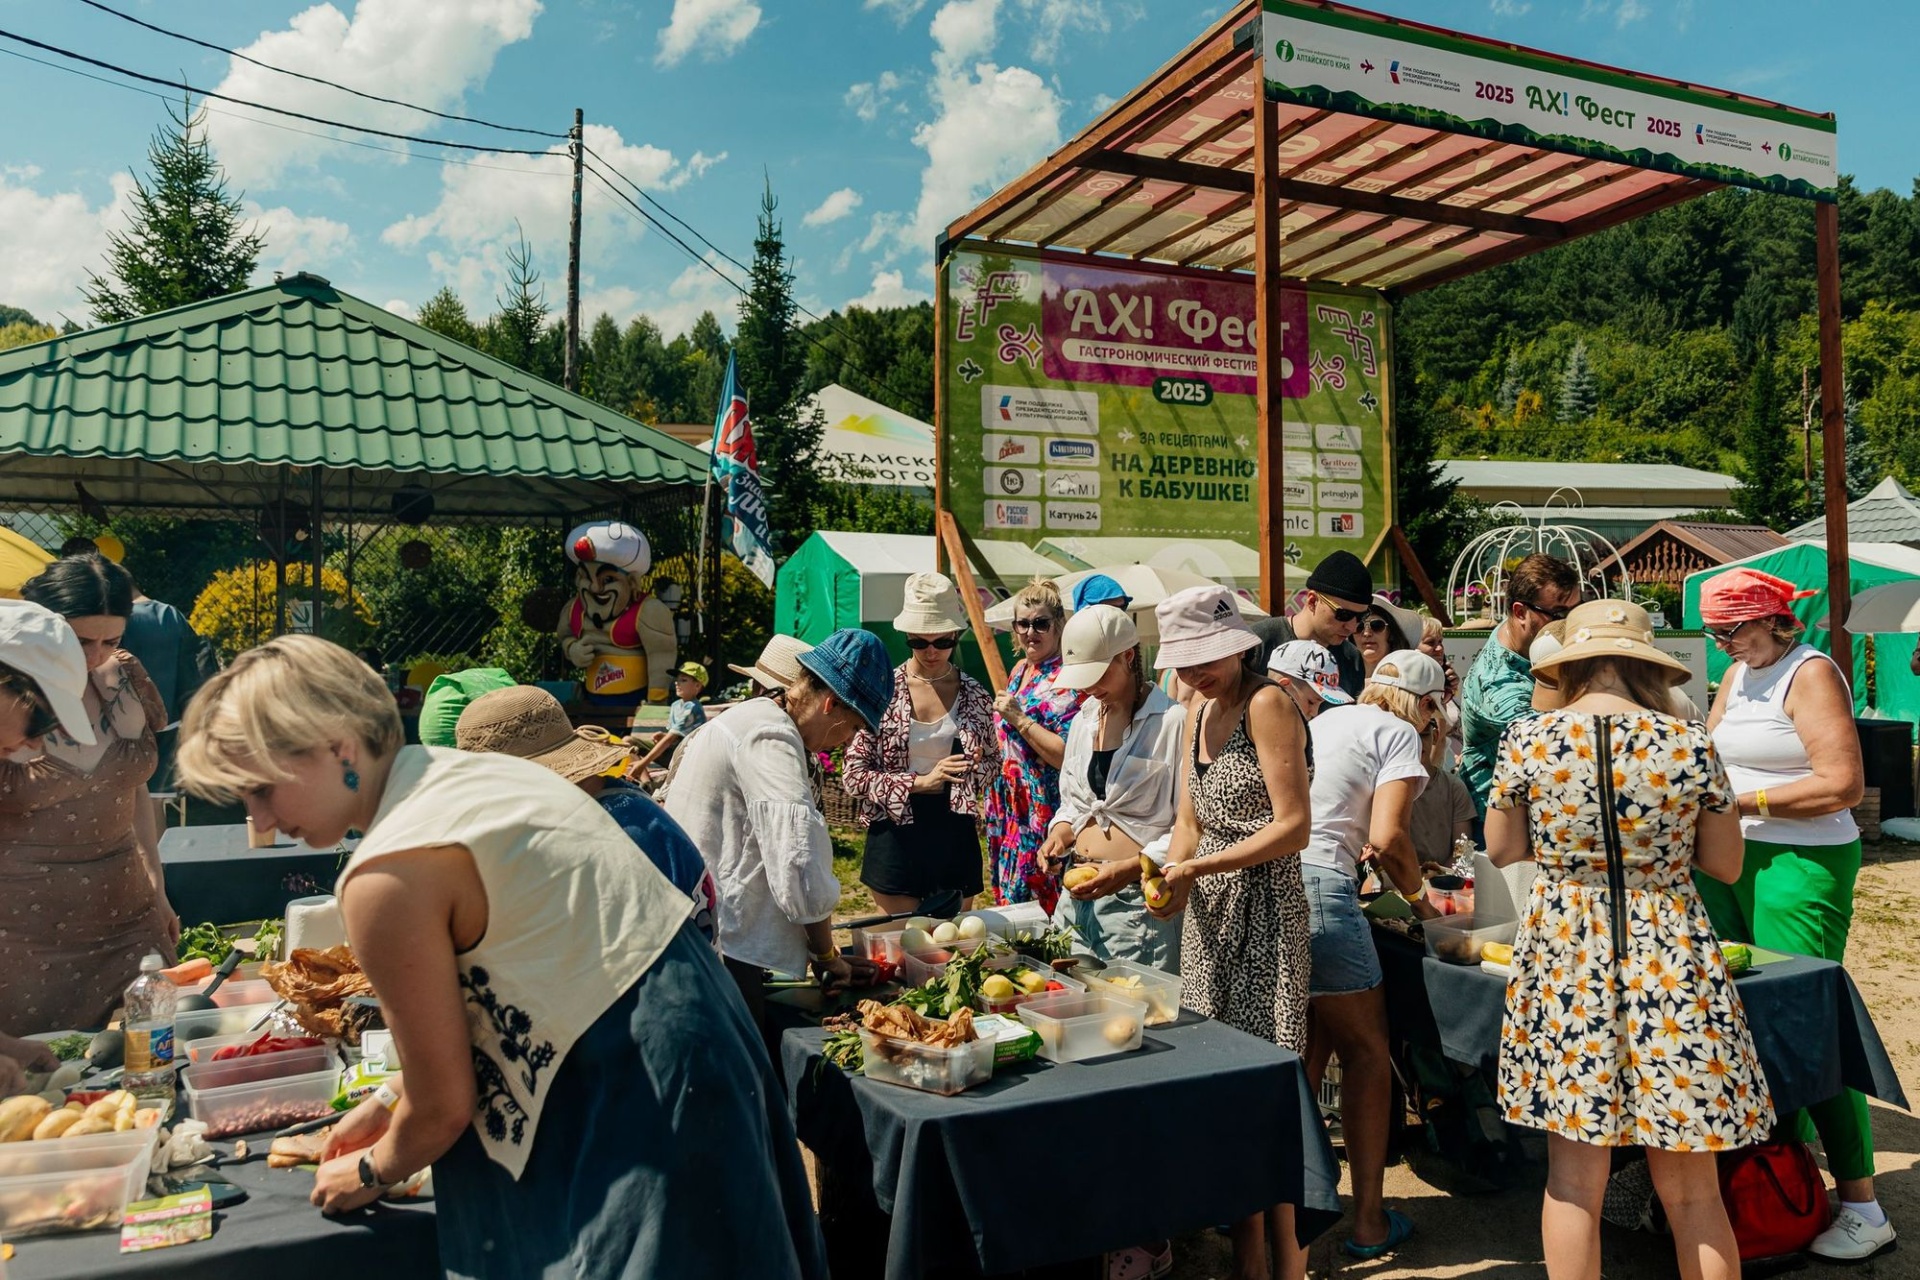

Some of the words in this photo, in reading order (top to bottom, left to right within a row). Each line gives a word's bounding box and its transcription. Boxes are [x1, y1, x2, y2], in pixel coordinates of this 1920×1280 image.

[1475, 81, 1514, 104] 2025
[1525, 85, 1569, 117] АХ!
[1575, 95, 1636, 129] Фест
[1646, 117, 1681, 138] 2025
[1063, 288, 1154, 341] АХ!
[1079, 345, 1211, 368] ГАСТРОНОМИЧЕСКИЙ
[1213, 357, 1258, 372] ФЕСТИВ
[1160, 381, 1207, 402] 2025
[1052, 444, 1092, 455] КИПРИНО
[1139, 431, 1155, 445] ЗА
[1160, 431, 1228, 449] РЕЦЕПТАМИ
[1111, 452, 1143, 473] НА
[1149, 454, 1256, 478] ДЕРЕВНЮ
[1119, 478, 1134, 498] К
[1139, 479, 1250, 502] БАБУШКЕ!
[1321, 489, 1359, 500] petroglyph
[1049, 509, 1085, 522] Катунь
[1085, 511, 1098, 521] 24
[1213, 611, 1234, 621] adidas
